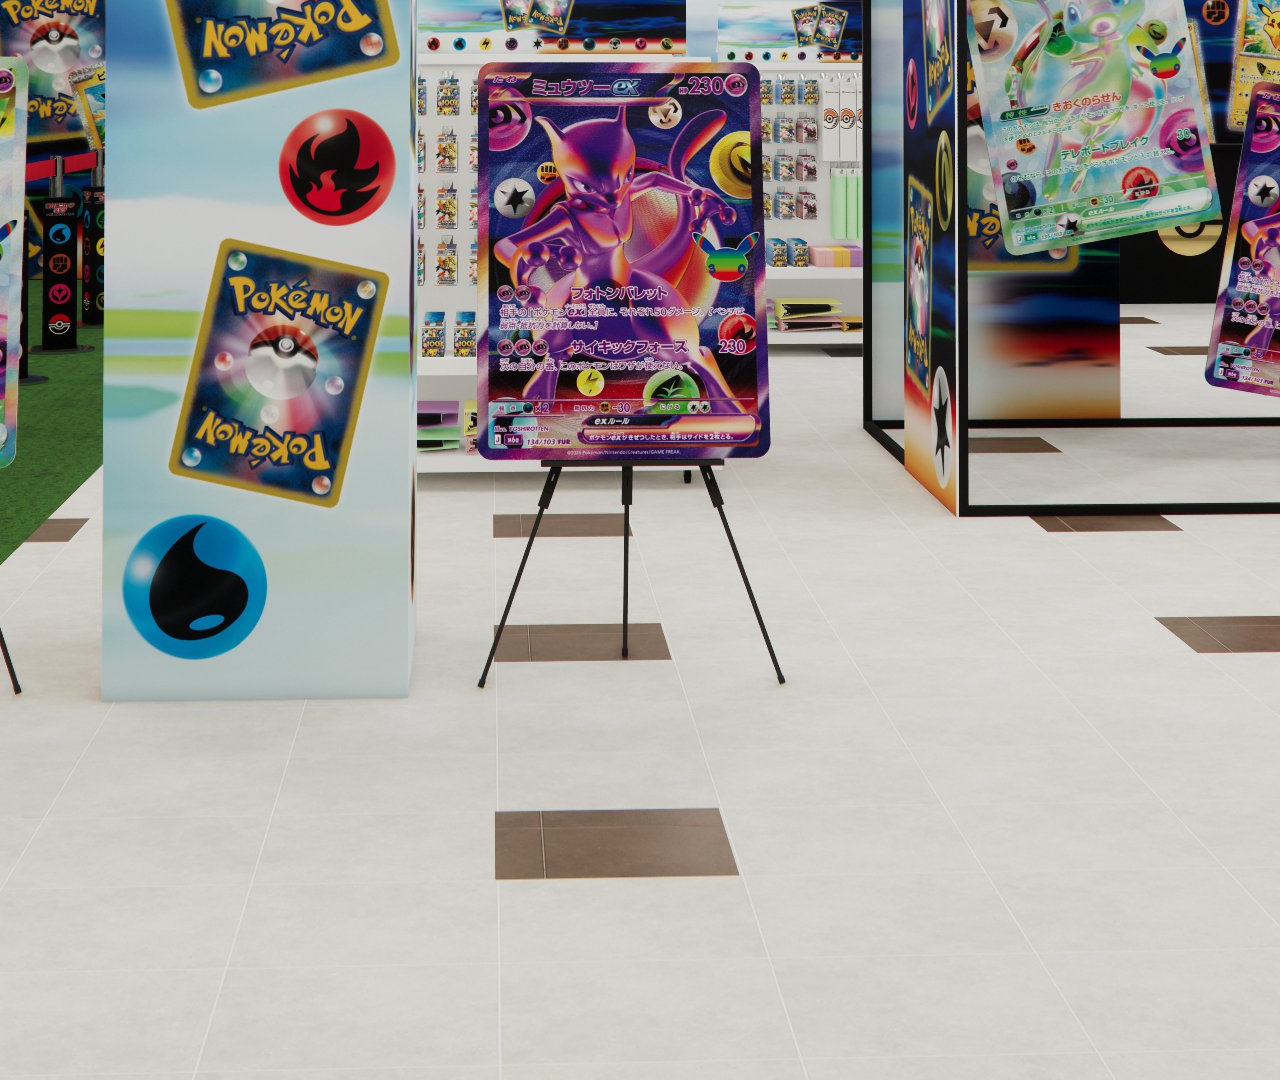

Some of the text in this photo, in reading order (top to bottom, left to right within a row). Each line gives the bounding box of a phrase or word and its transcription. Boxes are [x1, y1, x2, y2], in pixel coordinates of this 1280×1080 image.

[532, 78, 639, 96] ミュウツーex
[688, 77, 723, 95] 230
[1052, 94, 1121, 111] きおくのらせん
[1177, 129, 1191, 140] 30
[571, 286, 668, 300] フォトンバレット
[228, 276, 365, 336] Pokémon
[571, 339, 746, 353] サイキックフォース 230
